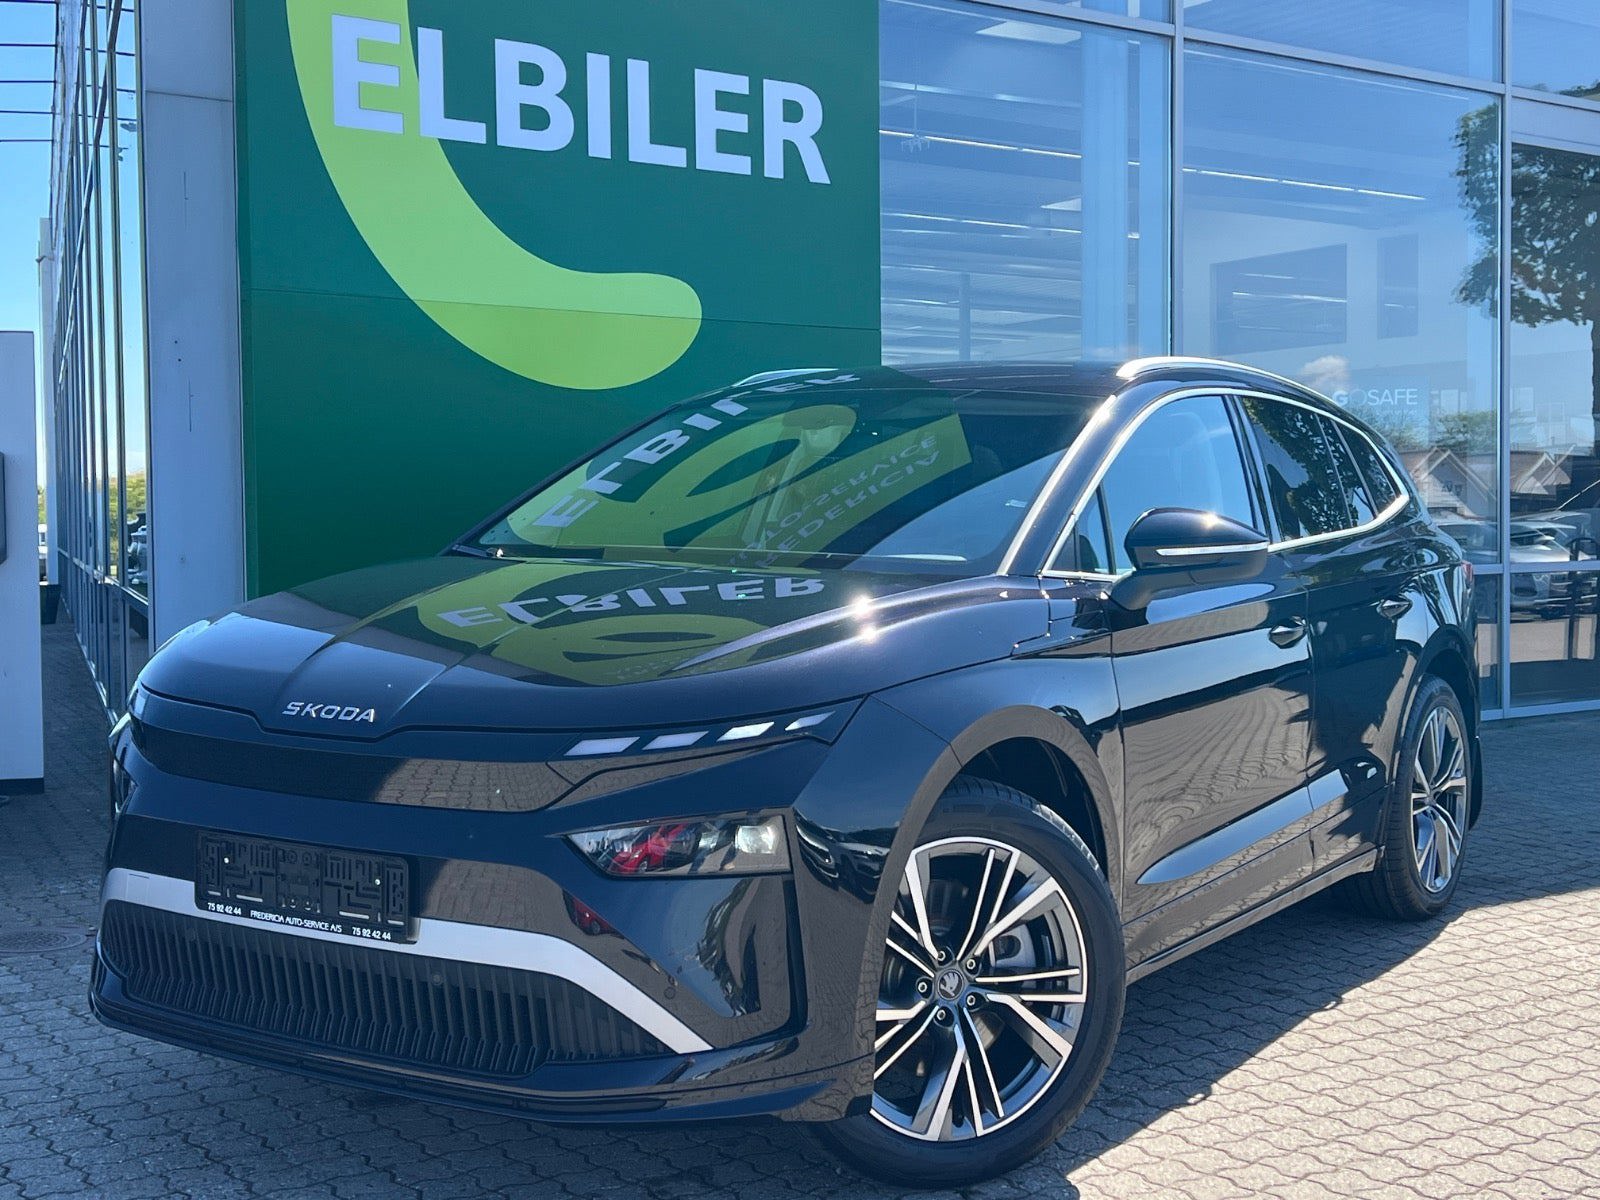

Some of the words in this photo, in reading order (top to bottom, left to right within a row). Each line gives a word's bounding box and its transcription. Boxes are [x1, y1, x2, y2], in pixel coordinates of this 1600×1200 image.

[331, 14, 831, 185] ELBILER
[207, 902, 216, 911] 75
[216, 904, 224, 913] 92
[224, 905, 233, 914] 42
[233, 907, 242, 916] 44
[250, 909, 285, 924] FREDERICIA
[285, 914, 330, 931] AUTO-SERVICE
[330, 921, 343, 933] A/S
[352, 926, 361, 936] 75
[362, 928, 371, 938] 92
[371, 930, 381, 939] 42
[381, 931, 392, 941] 44
